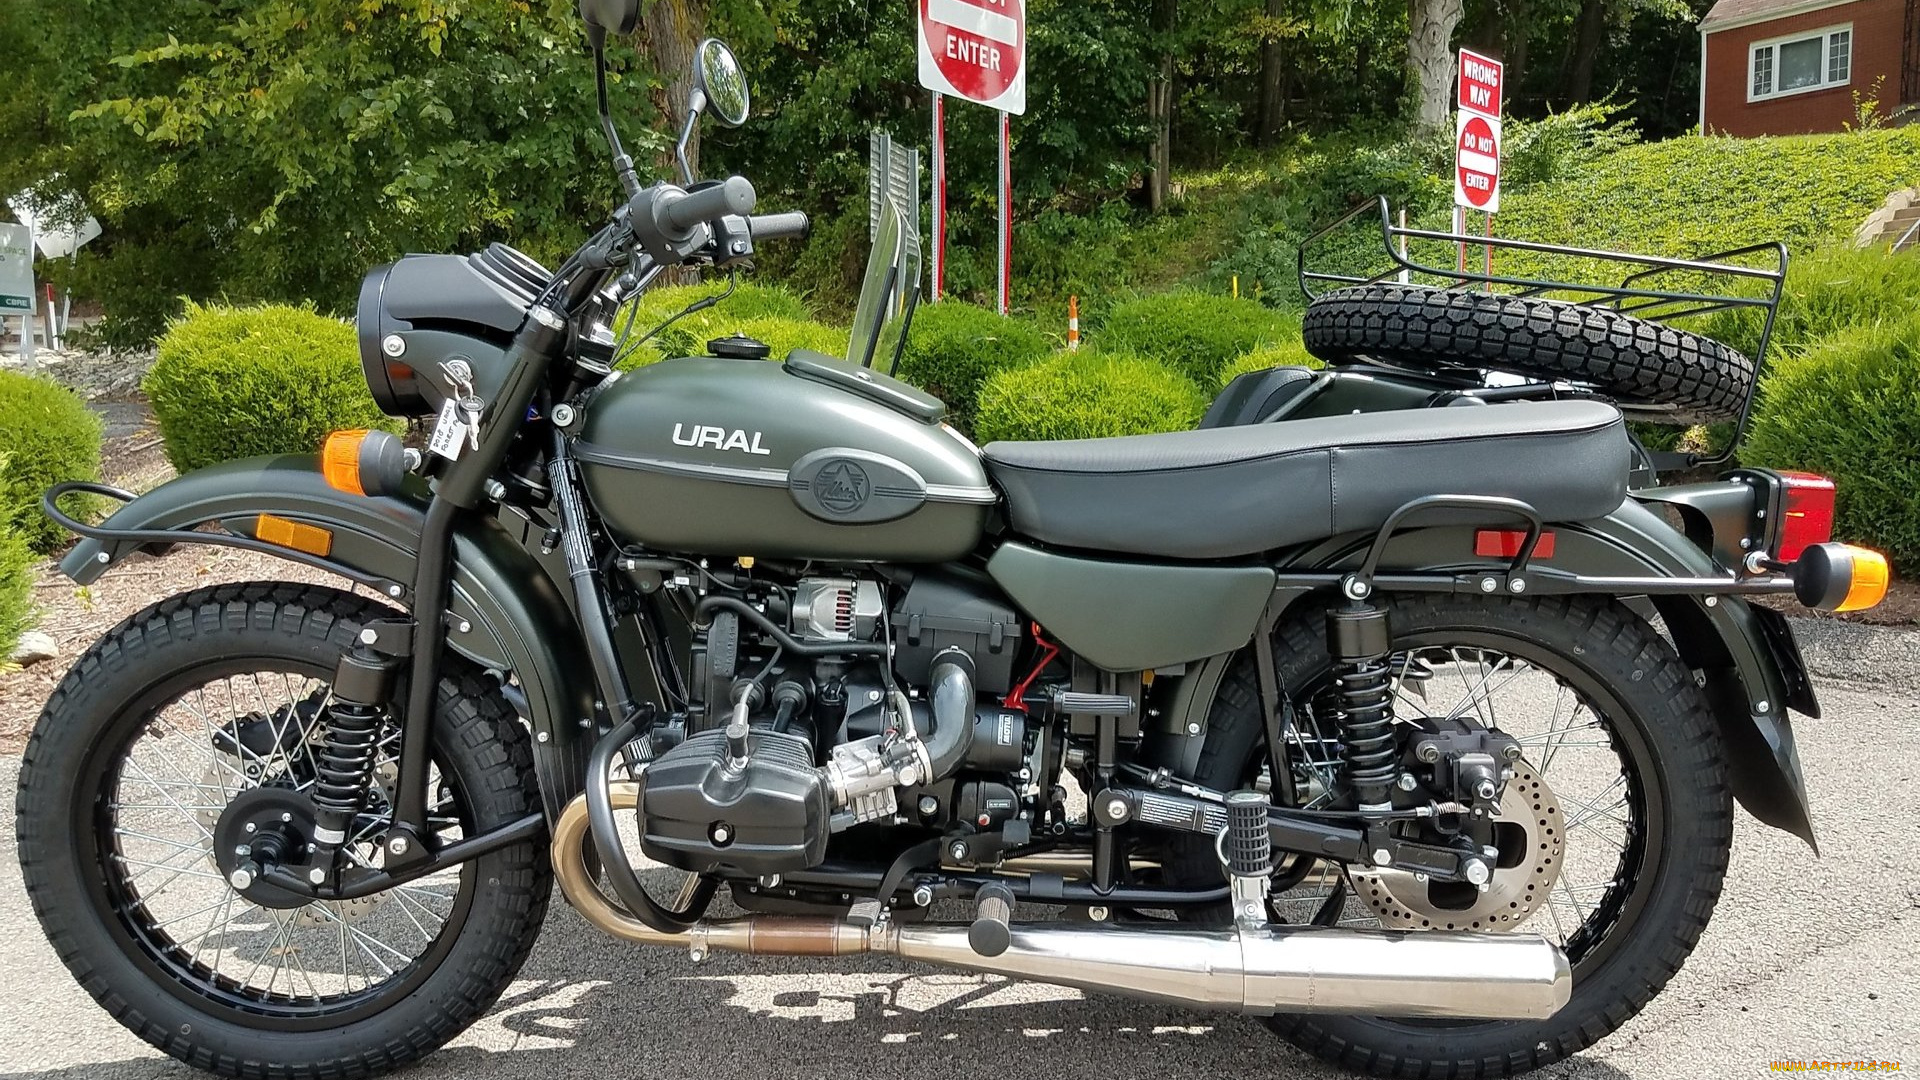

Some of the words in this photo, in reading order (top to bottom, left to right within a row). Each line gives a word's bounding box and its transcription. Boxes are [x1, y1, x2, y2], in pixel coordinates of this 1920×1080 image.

[946, 33, 1001, 72] ENTER
[1464, 58, 1498, 88] WRONG
[1470, 84, 1491, 108] WAY
[1464, 132, 1476, 149] DO
[1478, 136, 1493, 153] NOT
[1466, 171, 1489, 191] ENTER
[672, 422, 771, 455] URAL
[1003, 716, 1011, 744] MOTUL
